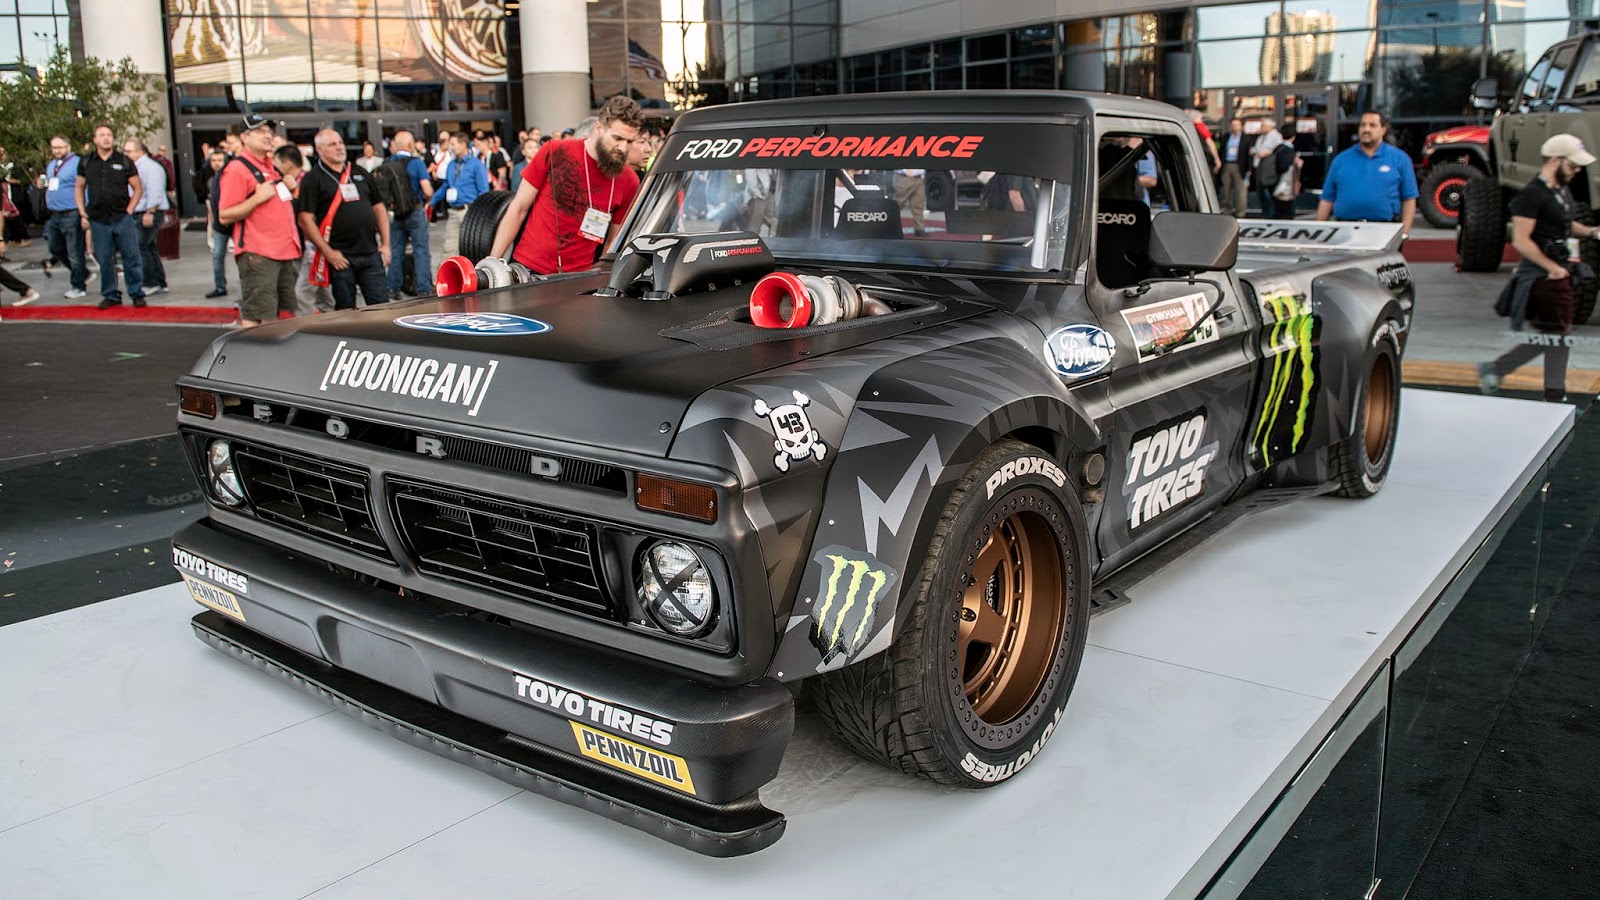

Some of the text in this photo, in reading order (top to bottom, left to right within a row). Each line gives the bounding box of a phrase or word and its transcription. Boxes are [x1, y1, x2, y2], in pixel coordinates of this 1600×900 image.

[676, 136, 985, 160] FORD PERFORMANCE
[847, 211, 888, 223] RECARO
[1097, 212, 1137, 226] ECARO
[1239, 227, 1340, 243] GAN]
[714, 250, 728, 258] FORD
[1145, 307, 1186, 323] GYMKHANA
[1058, 331, 1107, 370] Ford
[777, 412, 805, 435] 43
[1127, 415, 1205, 486] TOYO
[985, 457, 1067, 500] PROXES
[1131, 453, 1211, 530] TIRES
[172, 547, 248, 594] TOYO TIRES
[189, 579, 239, 613] PENNZOIL
[514, 674, 674, 746] TOYO TIRES
[581, 729, 684, 783] PENNZOIL
